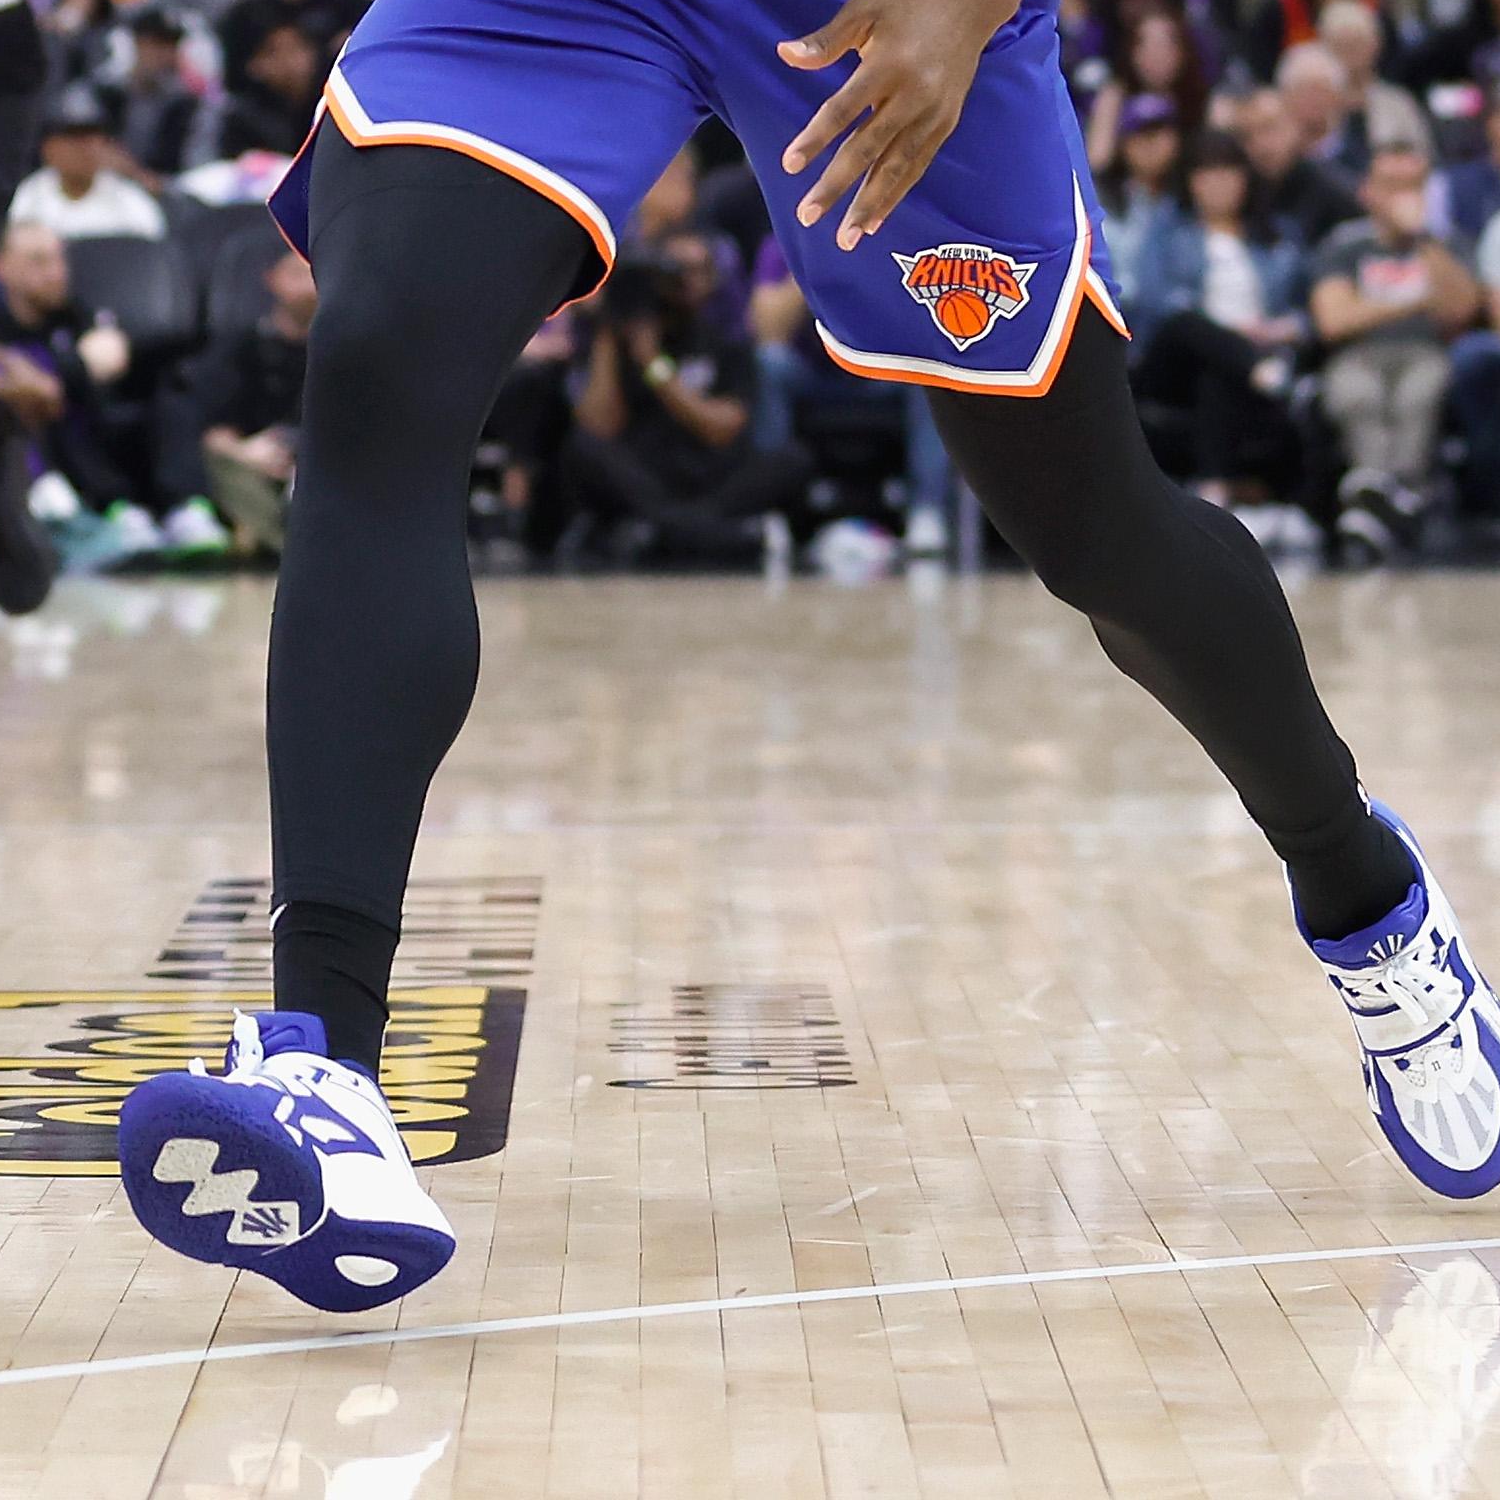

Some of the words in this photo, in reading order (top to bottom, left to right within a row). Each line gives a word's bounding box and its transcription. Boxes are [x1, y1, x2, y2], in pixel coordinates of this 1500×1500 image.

[940, 248, 962, 258] NEW
[964, 248, 990, 261] YORK
[906, 252, 1025, 304] KNICKS
